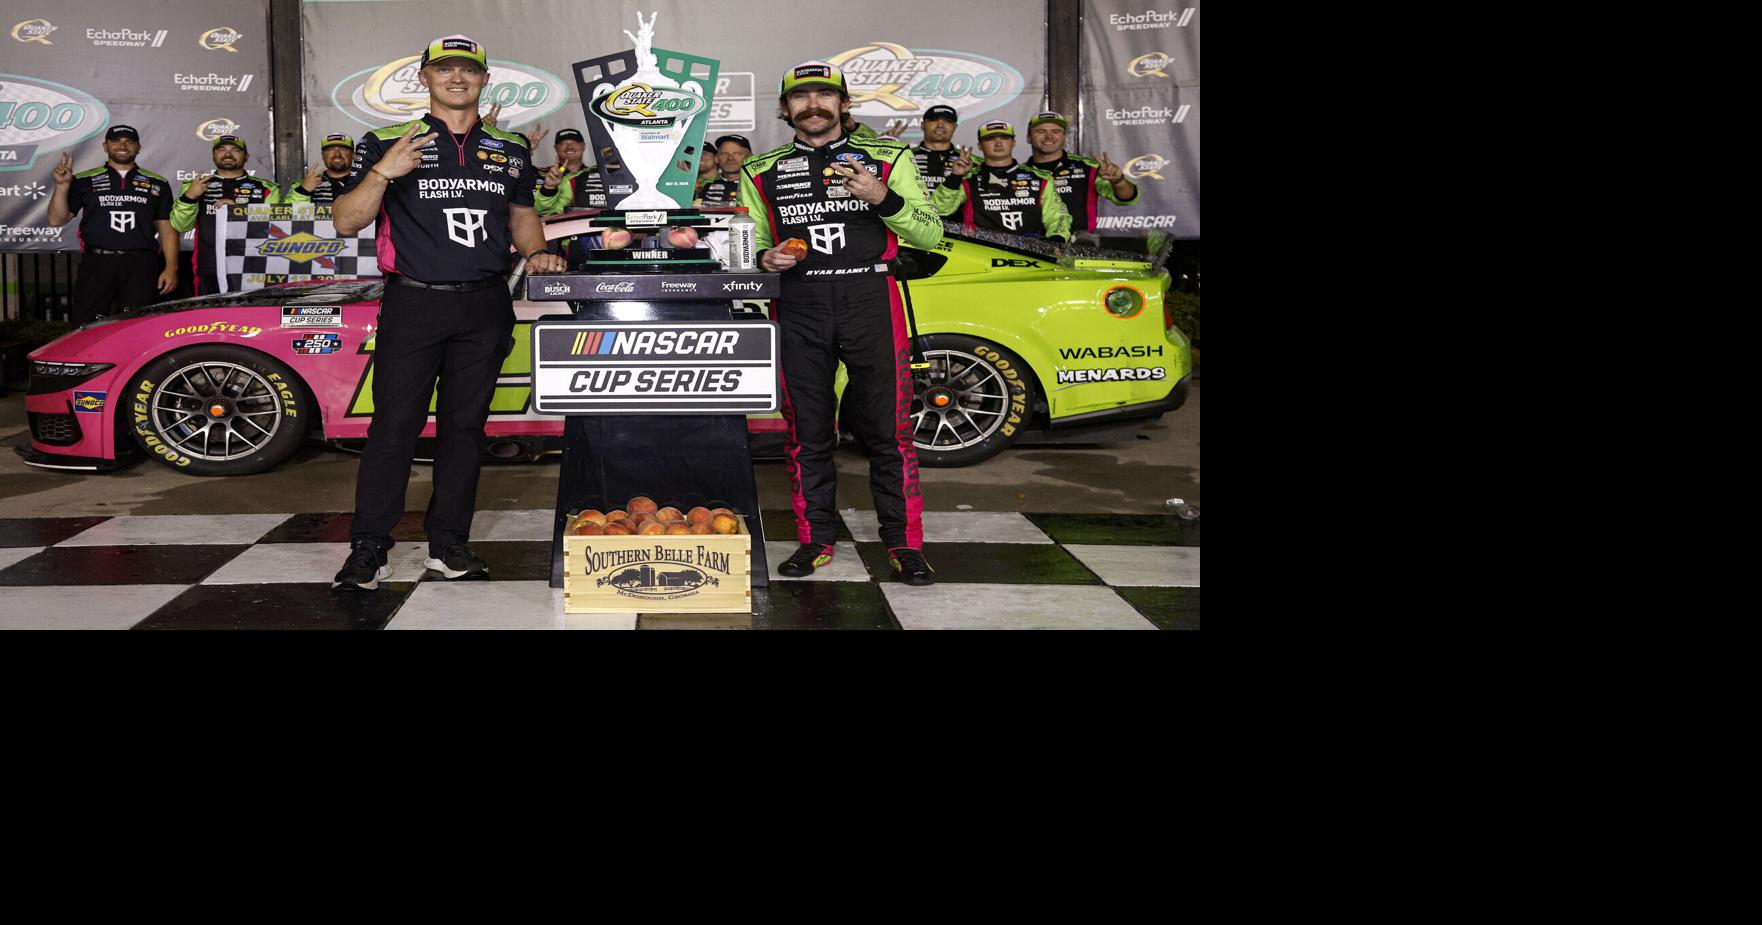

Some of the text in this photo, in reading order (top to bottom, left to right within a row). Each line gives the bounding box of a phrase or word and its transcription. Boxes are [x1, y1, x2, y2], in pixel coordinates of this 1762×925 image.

[1110, 10, 1177, 24] EchoPark
[1117, 22, 1171, 31] SPEEDWAY
[86, 28, 151, 40] EchoPark
[843, 58, 933, 73] QUAKER
[174, 73, 237, 85] EchoPark
[850, 71, 914, 85] STATE
[908, 72, 1002, 99] 400
[620, 91, 662, 99] QUAKER
[651, 97, 696, 111] 400
[1106, 106, 1173, 120] EchoPark
[1112, 118, 1166, 126] SPEEDWAY
[418, 178, 505, 196] BODYARMOR
[98, 195, 148, 204] BODYARMOR
[420, 190, 464, 199] FLASH I.V.
[983, 197, 1036, 206] BODYARMOR
[233, 206, 333, 216] QUAKER STAT
[778, 200, 870, 217] BODYARMOR
[782, 213, 824, 225] FLASH I.V.
[1111, 215, 1176, 229] NASCAR
[0, 224, 63, 237] Freeway
[263, 241, 340, 253] SUNOCO
[742, 230, 750, 263] BODYARMOR
[632, 251, 668, 259] WINNER
[991, 258, 1041, 268] DEX
[247, 274, 286, 283] JULY
[661, 281, 697, 289] Freeway
[544, 285, 570, 293] BUSCH
[722, 281, 763, 291] xfinity
[164, 321, 262, 338] GOODYEAR
[611, 331, 740, 355] NASCAR
[1059, 345, 1163, 360] WABASH
[569, 369, 743, 393] CUP SERIES
[1057, 367, 1166, 384] MENARDS
[267, 372, 297, 418] EAGLE
[974, 345, 1026, 438] GOODYEAR
[135, 380, 191, 467] GOODYEAR
[585, 545, 731, 575] SOUTHERN BELLE FARM
